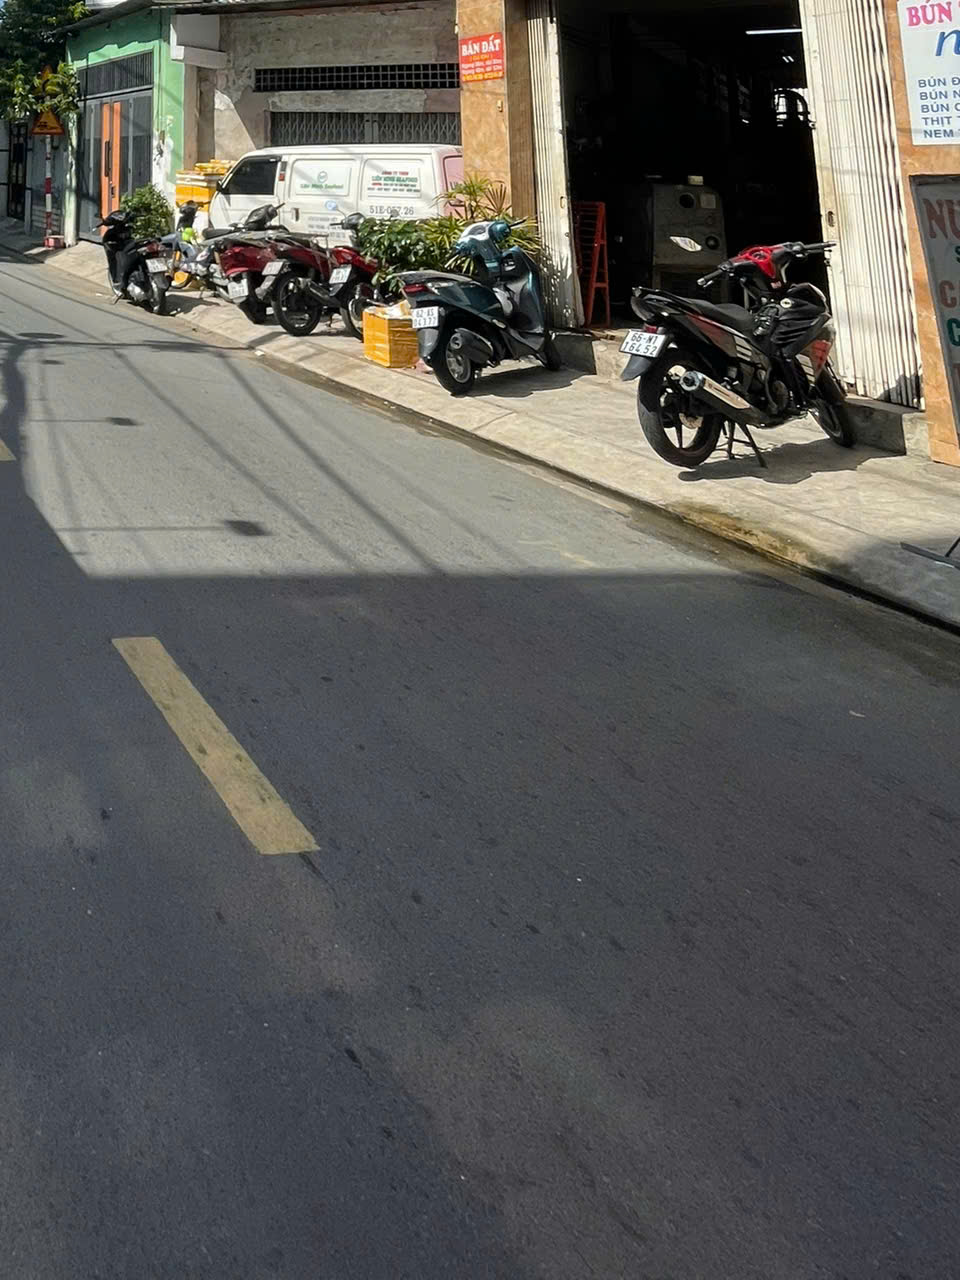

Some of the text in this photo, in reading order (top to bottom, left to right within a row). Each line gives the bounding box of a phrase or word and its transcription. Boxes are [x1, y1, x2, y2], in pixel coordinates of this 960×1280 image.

[461, 40, 480, 57] BÁN
[918, 76, 947, 88] BÚN
[919, 88, 948, 101] BÚN
[920, 101, 950, 113] BÚN
[921, 115, 953, 127] THỊT
[923, 128, 954, 139] NEM
